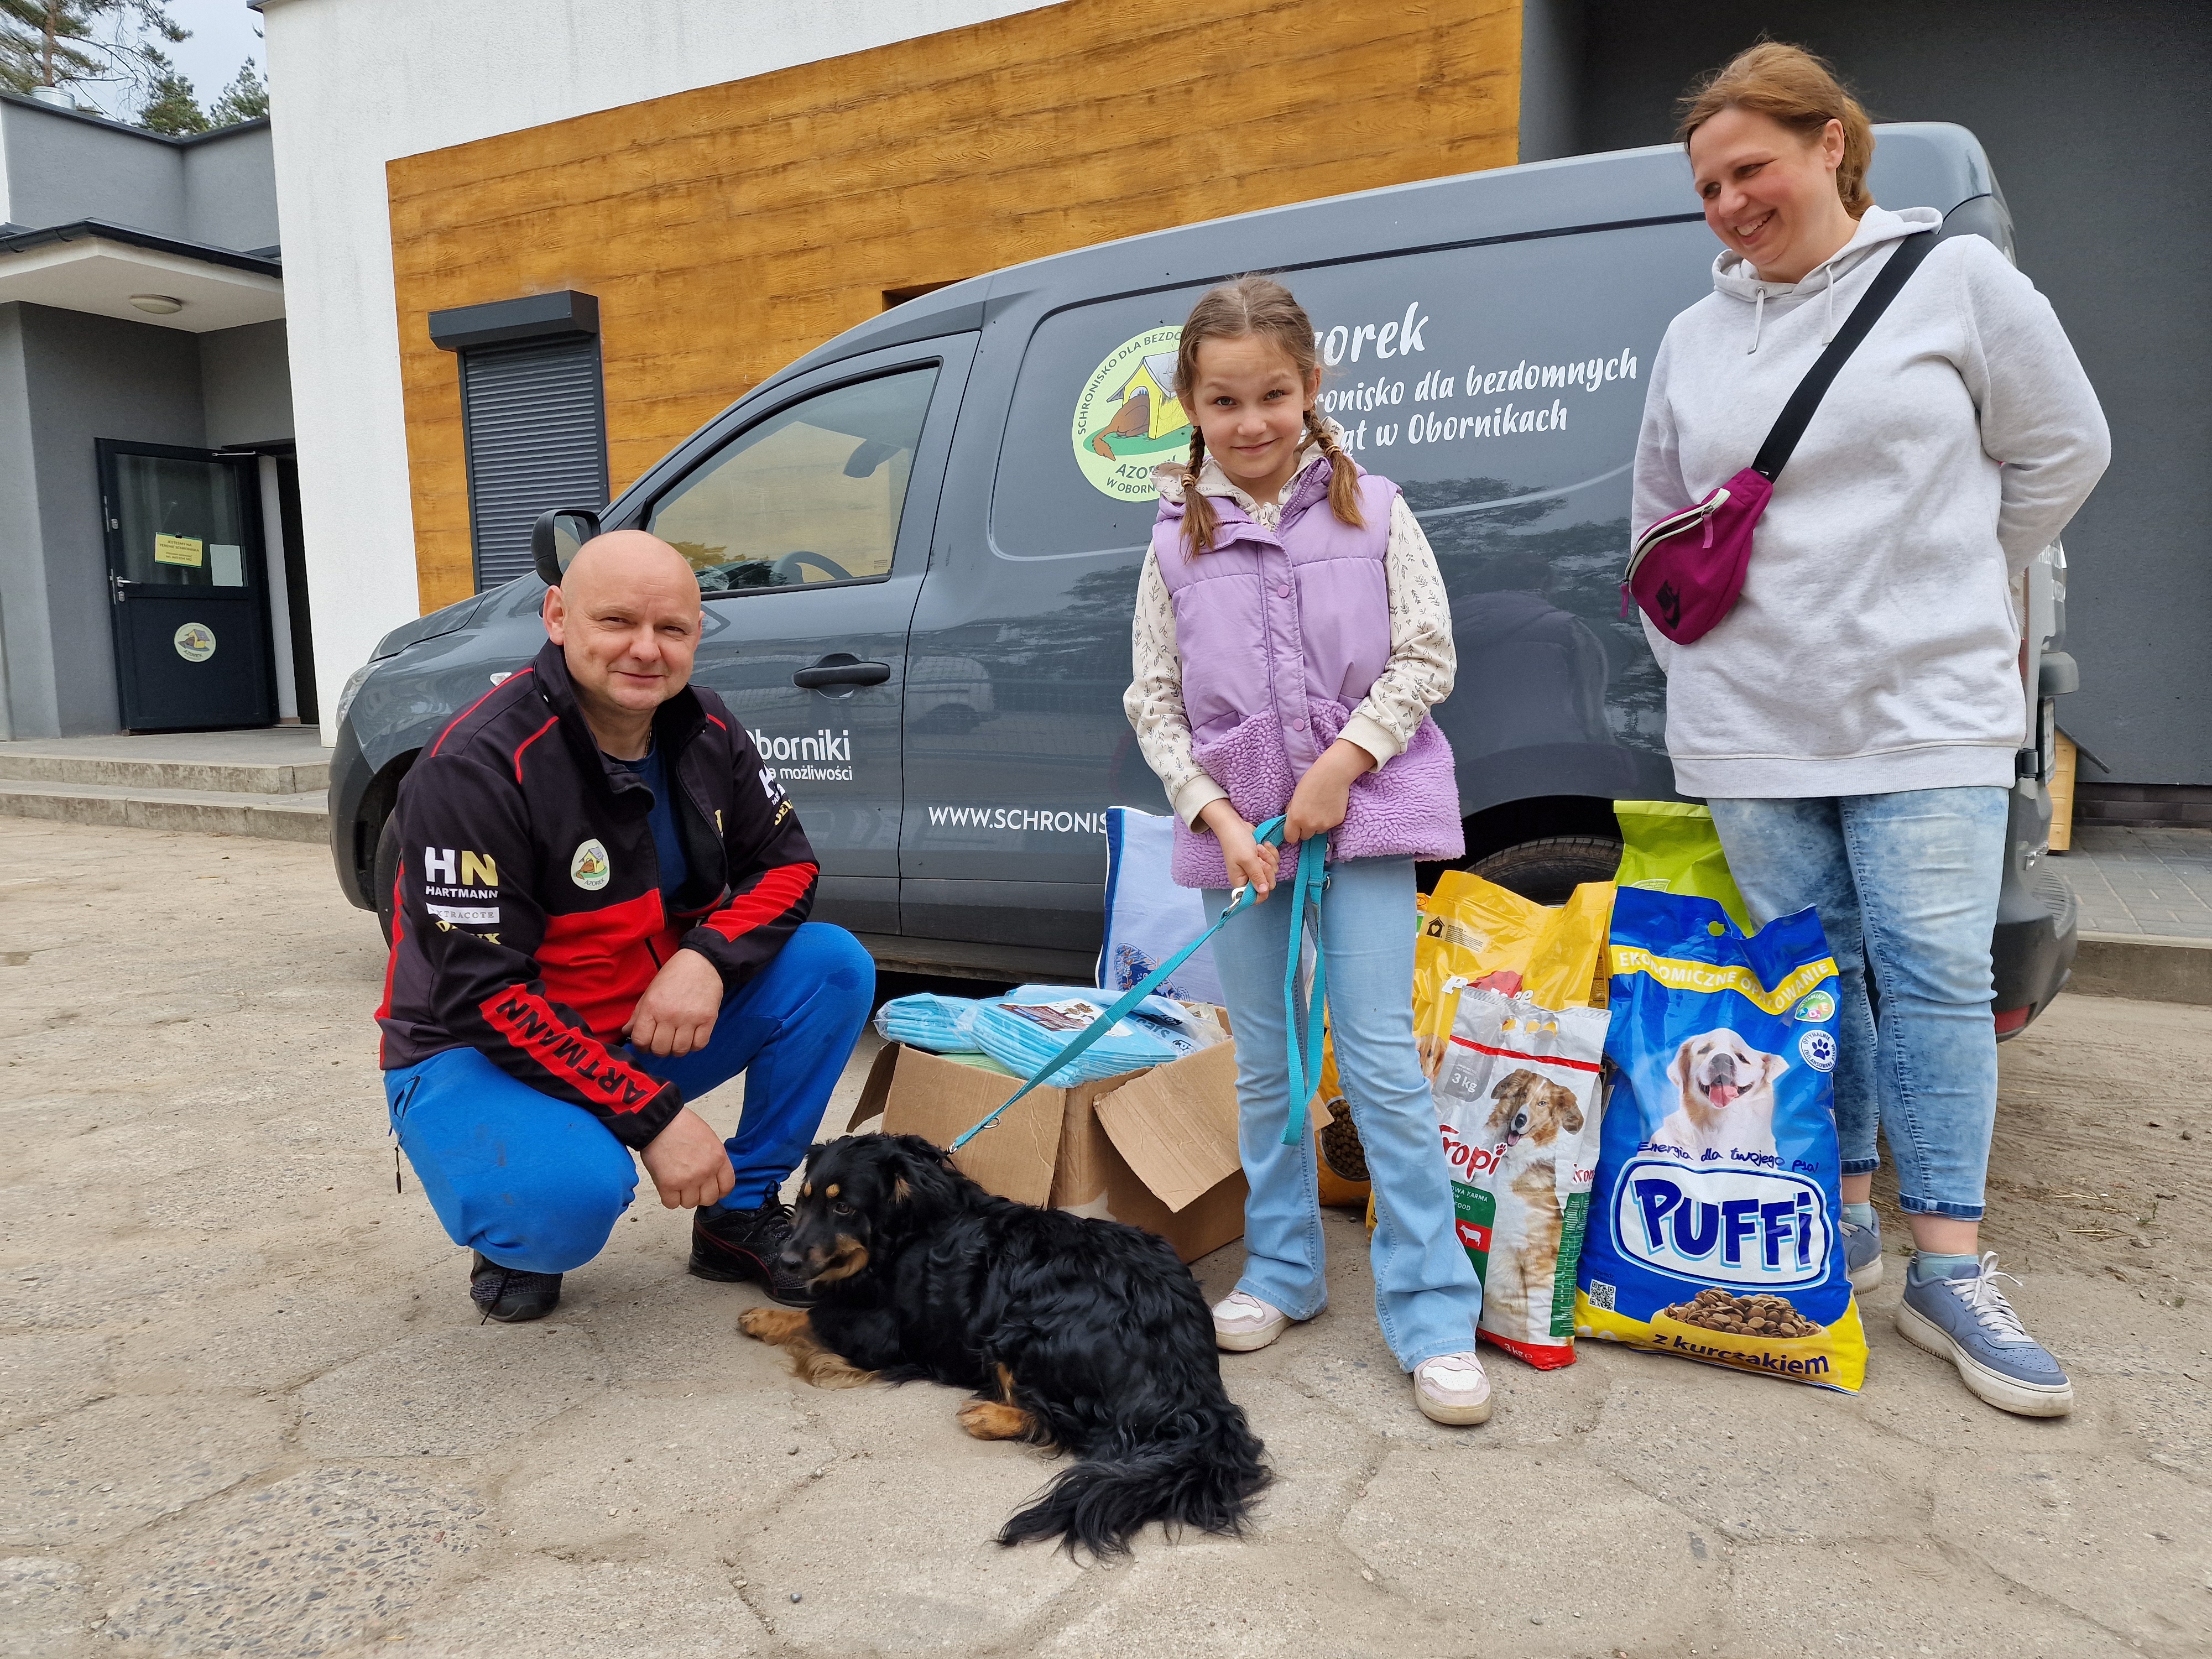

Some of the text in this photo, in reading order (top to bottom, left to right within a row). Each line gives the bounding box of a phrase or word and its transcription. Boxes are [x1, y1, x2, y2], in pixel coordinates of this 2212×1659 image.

[1314, 301, 1429, 366] orek
[1415, 369, 1454, 401] dla
[1465, 347, 1637, 392] bezdomnych
[1077, 358, 1117, 435] SCHRONISKO
[1118, 341, 1141, 361] DLA
[1376, 423, 1399, 446] w
[1408, 399, 1567, 444] Obornikach
[1107, 477, 1117, 488] W
[780, 765, 853, 781] możliwości
[424, 847, 499, 886] HN
[425, 885, 498, 899] HARTMANN
[584, 878, 605, 886] AZOREK
[435, 910, 494, 919] XTRACOTE
[1619, 952, 1737, 987] EKONOMICZNE
[1740, 962, 1830, 1011] OPAKOWANIE
[1821, 1003, 1829, 1011] E
[1803, 1032, 1831, 1045] OPTYMALNIE
[495, 999, 649, 1104] ARTMANN
[1452, 1073, 1478, 1093] 3 kg
[1637, 1141, 1694, 1160] Energia
[1700, 1147, 1724, 1162] dla
[1730, 1147, 1785, 1168] twojego
[1467, 1191, 1488, 1202] KARMA
[1504, 1343, 1511, 1352] 3
[1652, 1333, 1830, 1375] z kurczakiem
